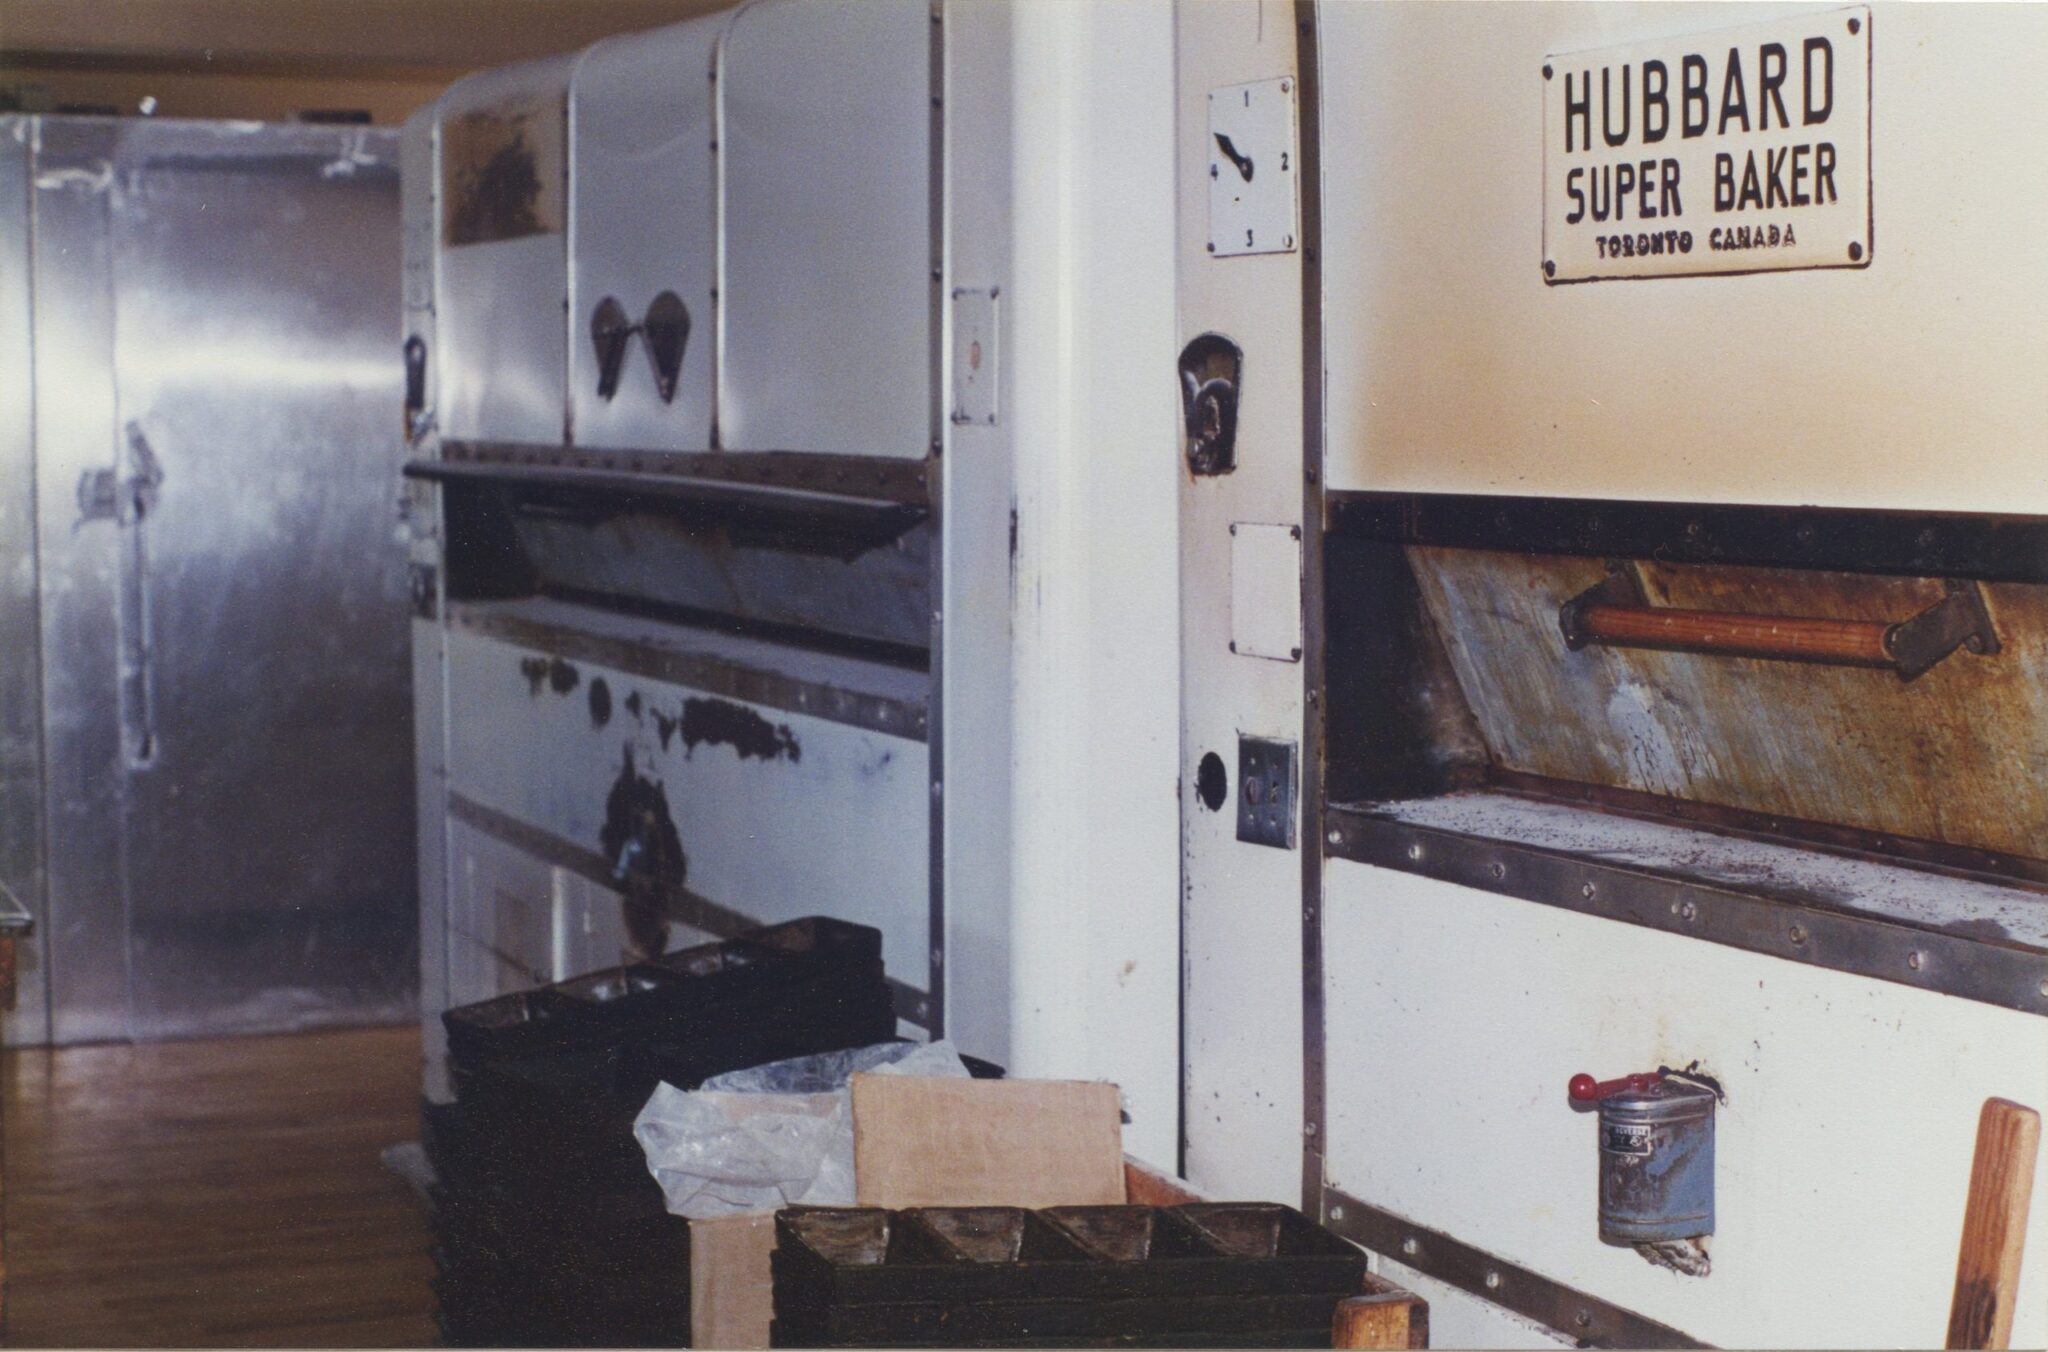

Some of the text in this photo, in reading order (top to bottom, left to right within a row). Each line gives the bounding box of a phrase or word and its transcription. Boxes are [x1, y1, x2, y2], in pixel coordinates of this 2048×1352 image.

[1565, 37, 1834, 153] HUBBARD
[1281, 152, 1289, 171] 2
[1566, 142, 1837, 225] SUPER BAKER
[1596, 223, 1796, 259] TORONTO CANADA
